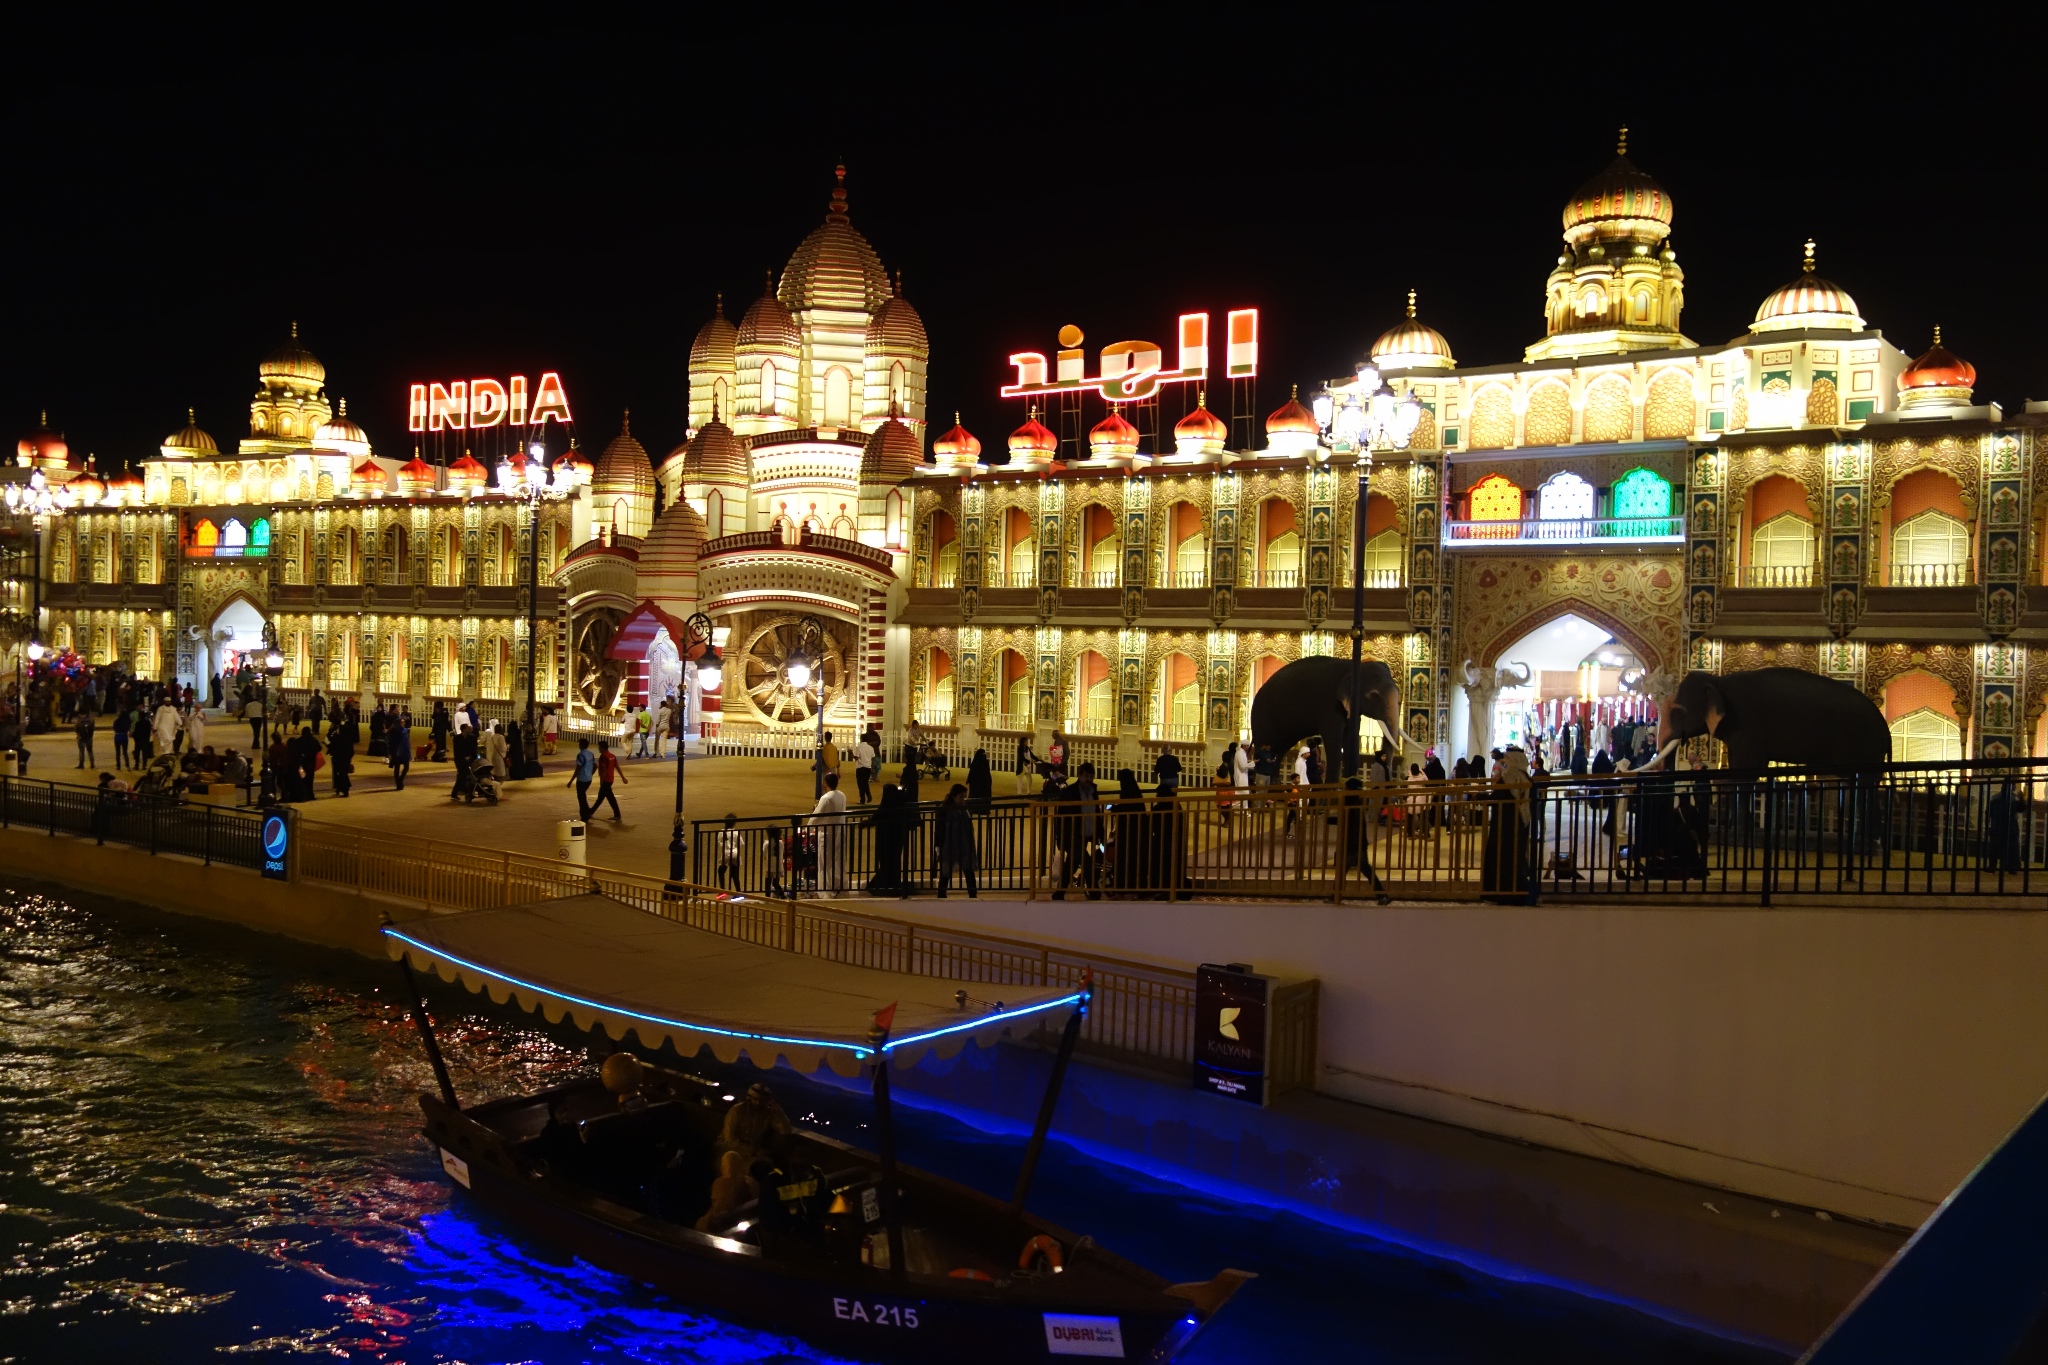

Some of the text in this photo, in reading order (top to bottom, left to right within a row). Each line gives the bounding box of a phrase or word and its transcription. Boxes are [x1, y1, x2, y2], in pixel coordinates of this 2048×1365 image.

[1001, 308, 1258, 402] الهند
[409, 372, 572, 432] INDIA
[265, 861, 284, 872] pepsi
[1207, 1040, 1251, 1060] KALYAN
[833, 1297, 919, 1329] EA 215
[1053, 1327, 1095, 1342] DUBAI
